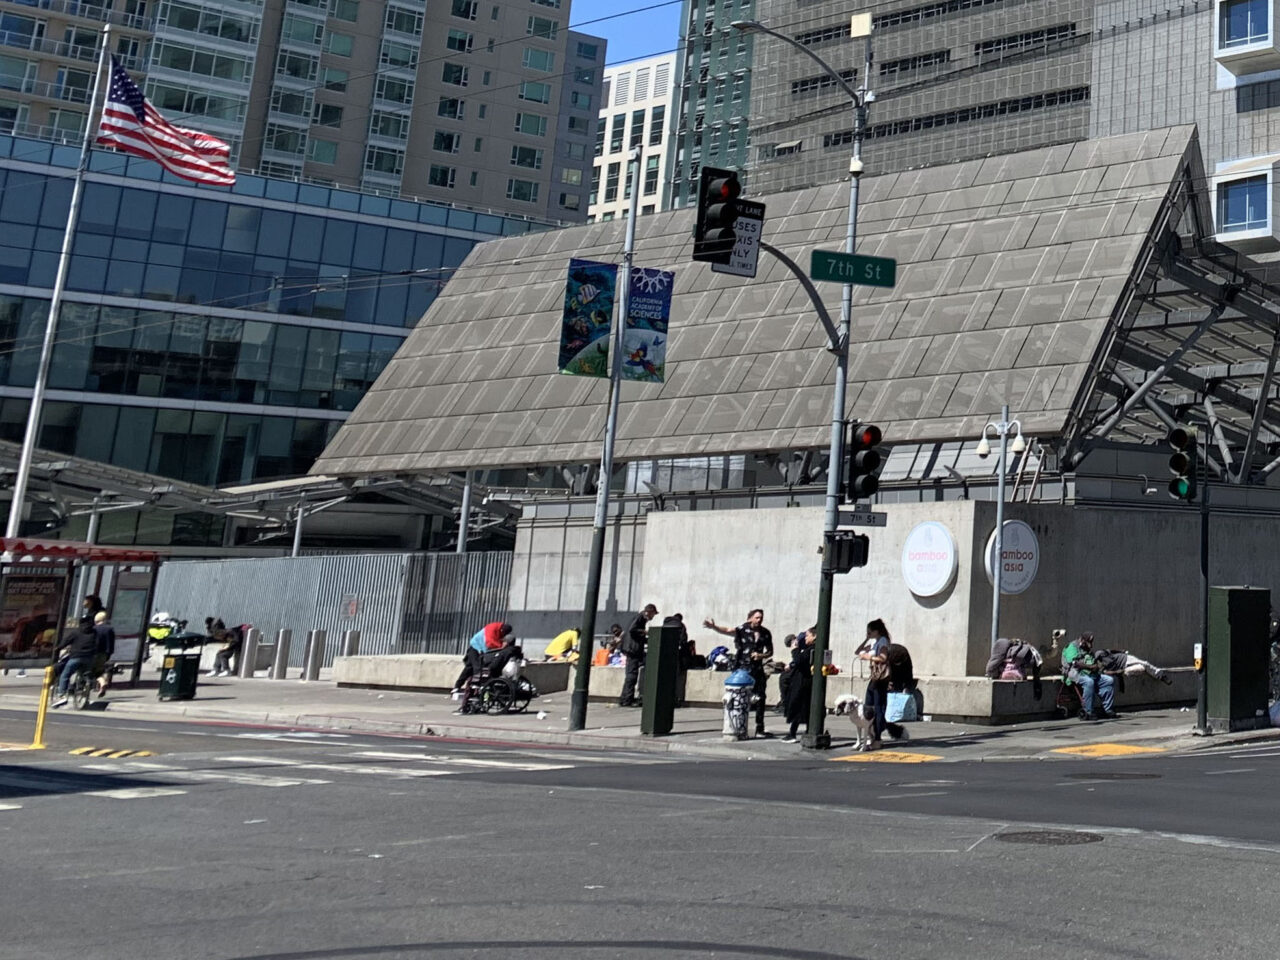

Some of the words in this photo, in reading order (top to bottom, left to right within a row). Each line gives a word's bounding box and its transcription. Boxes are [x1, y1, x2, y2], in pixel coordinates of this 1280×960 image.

[737, 235, 753, 246] XIS
[732, 247, 750, 259] NLY
[827, 259, 854, 276] 7th
[864, 263, 881, 280] St
[630, 309, 662, 319] SCIENCES
[908, 551, 948, 560] bamboo
[1001, 549, 1034, 560] amboo
[1003, 563, 1024, 572] asia
